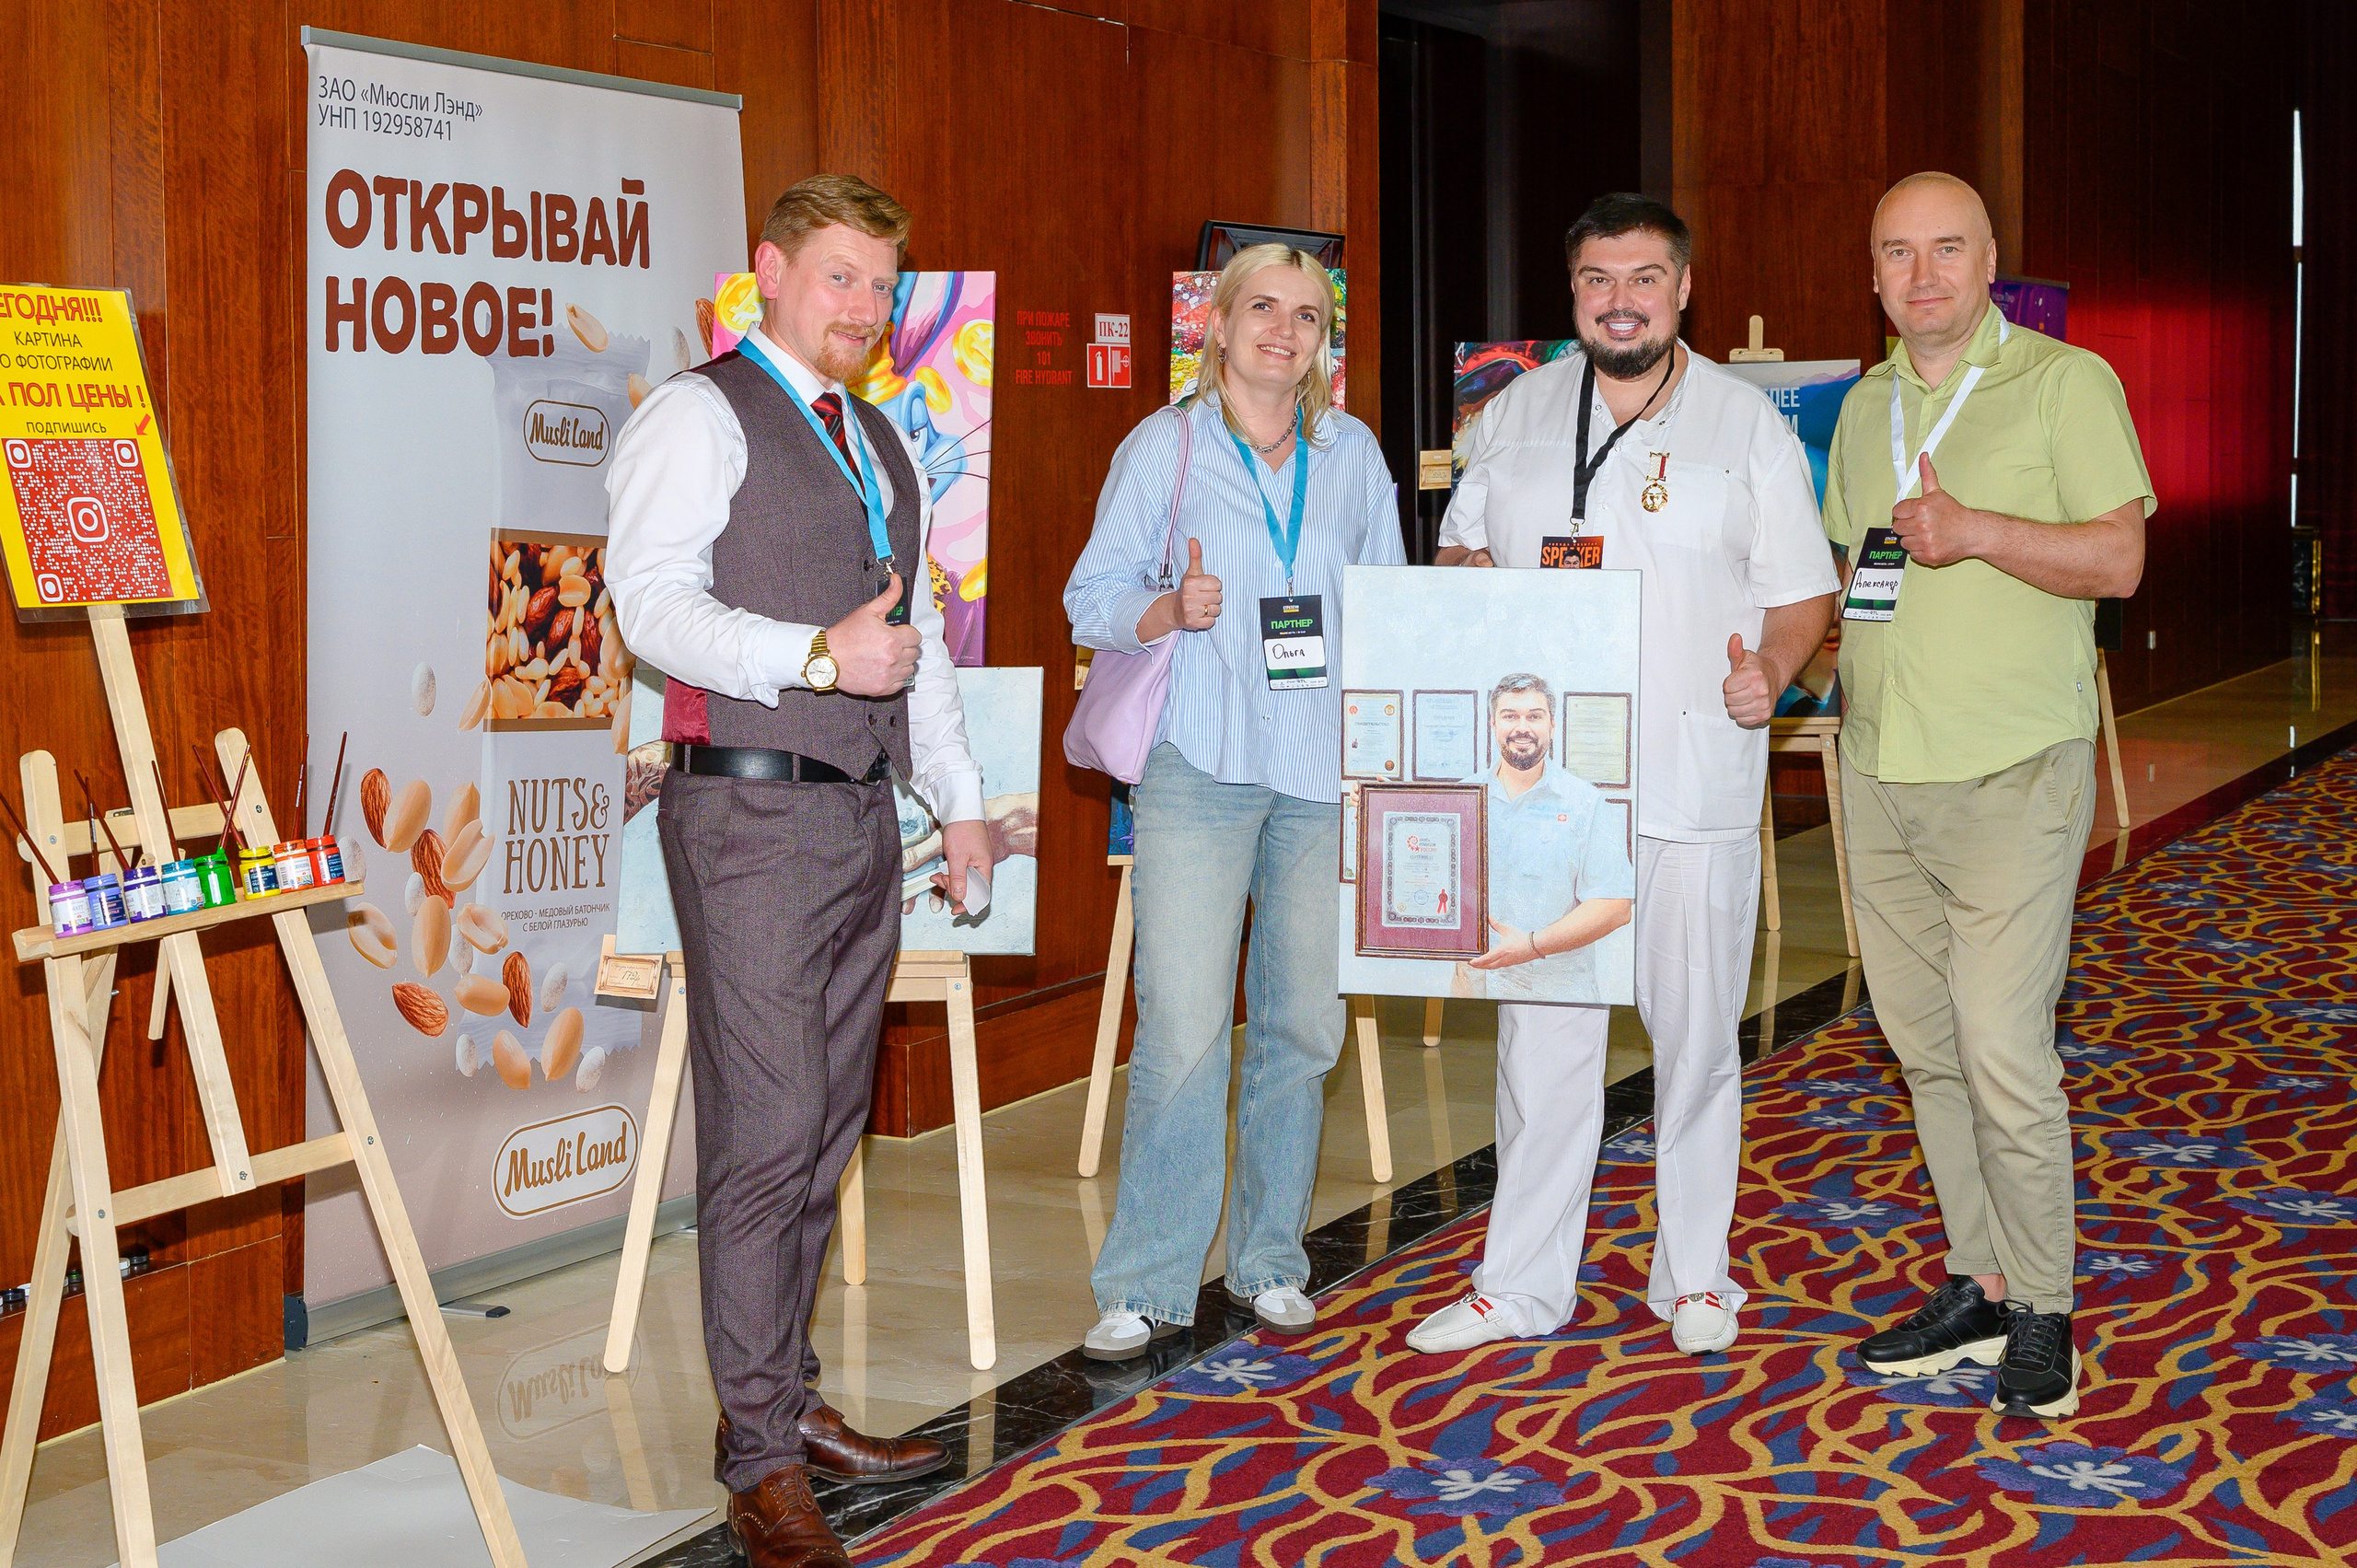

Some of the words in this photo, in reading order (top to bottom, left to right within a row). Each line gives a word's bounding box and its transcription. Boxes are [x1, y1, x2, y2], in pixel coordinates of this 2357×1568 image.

[318, 75, 356, 102] ЗАО
[360, 83, 429, 112] «Мюсли
[433, 91, 483, 122] Лэнд»
[318, 103, 356, 130] УНП
[363, 110, 452, 142] 192958741
[325, 168, 650, 269] ОТКРЫВАЙ
[325, 276, 554, 357] НОВОЕ!
[1016, 310, 1034, 326] ПРИ
[1036, 311, 1071, 328] ПОЖАРЕ
[1025, 331, 1062, 346] ЗВОНИТЬ
[1098, 321, 1129, 338] ПК-22
[14, 331, 83, 348] КАРТИНА
[16, 354, 113, 372] ФОТОГРАФИИ
[1037, 351, 1051, 366] 101
[1016, 369, 1033, 385] FIRE
[1035, 370, 1073, 386] HYDRANT
[8, 382, 62, 407] ПОЛ
[66, 384, 133, 412] ЦЕНЫ
[529, 412, 570, 447] Musli
[572, 417, 604, 450] Land
[1541, 546, 1601, 568] SPEKER
[1868, 551, 1903, 560] ПАРТНЕР
[1271, 619, 1313, 630] ПАРТНЕР
[503, 833, 610, 894] HONEY
[501, 910, 534, 921] ОРЕХОВО
[539, 905, 574, 919] МЕДОВЫЙ
[575, 902, 610, 916] БАТОНЧИК
[529, 920, 552, 932] БЕЛОЙ
[553, 917, 588, 930] ГЛАЗУРЬЮ
[505, 1138, 573, 1197] Musli
[575, 1121, 627, 1176] Land
